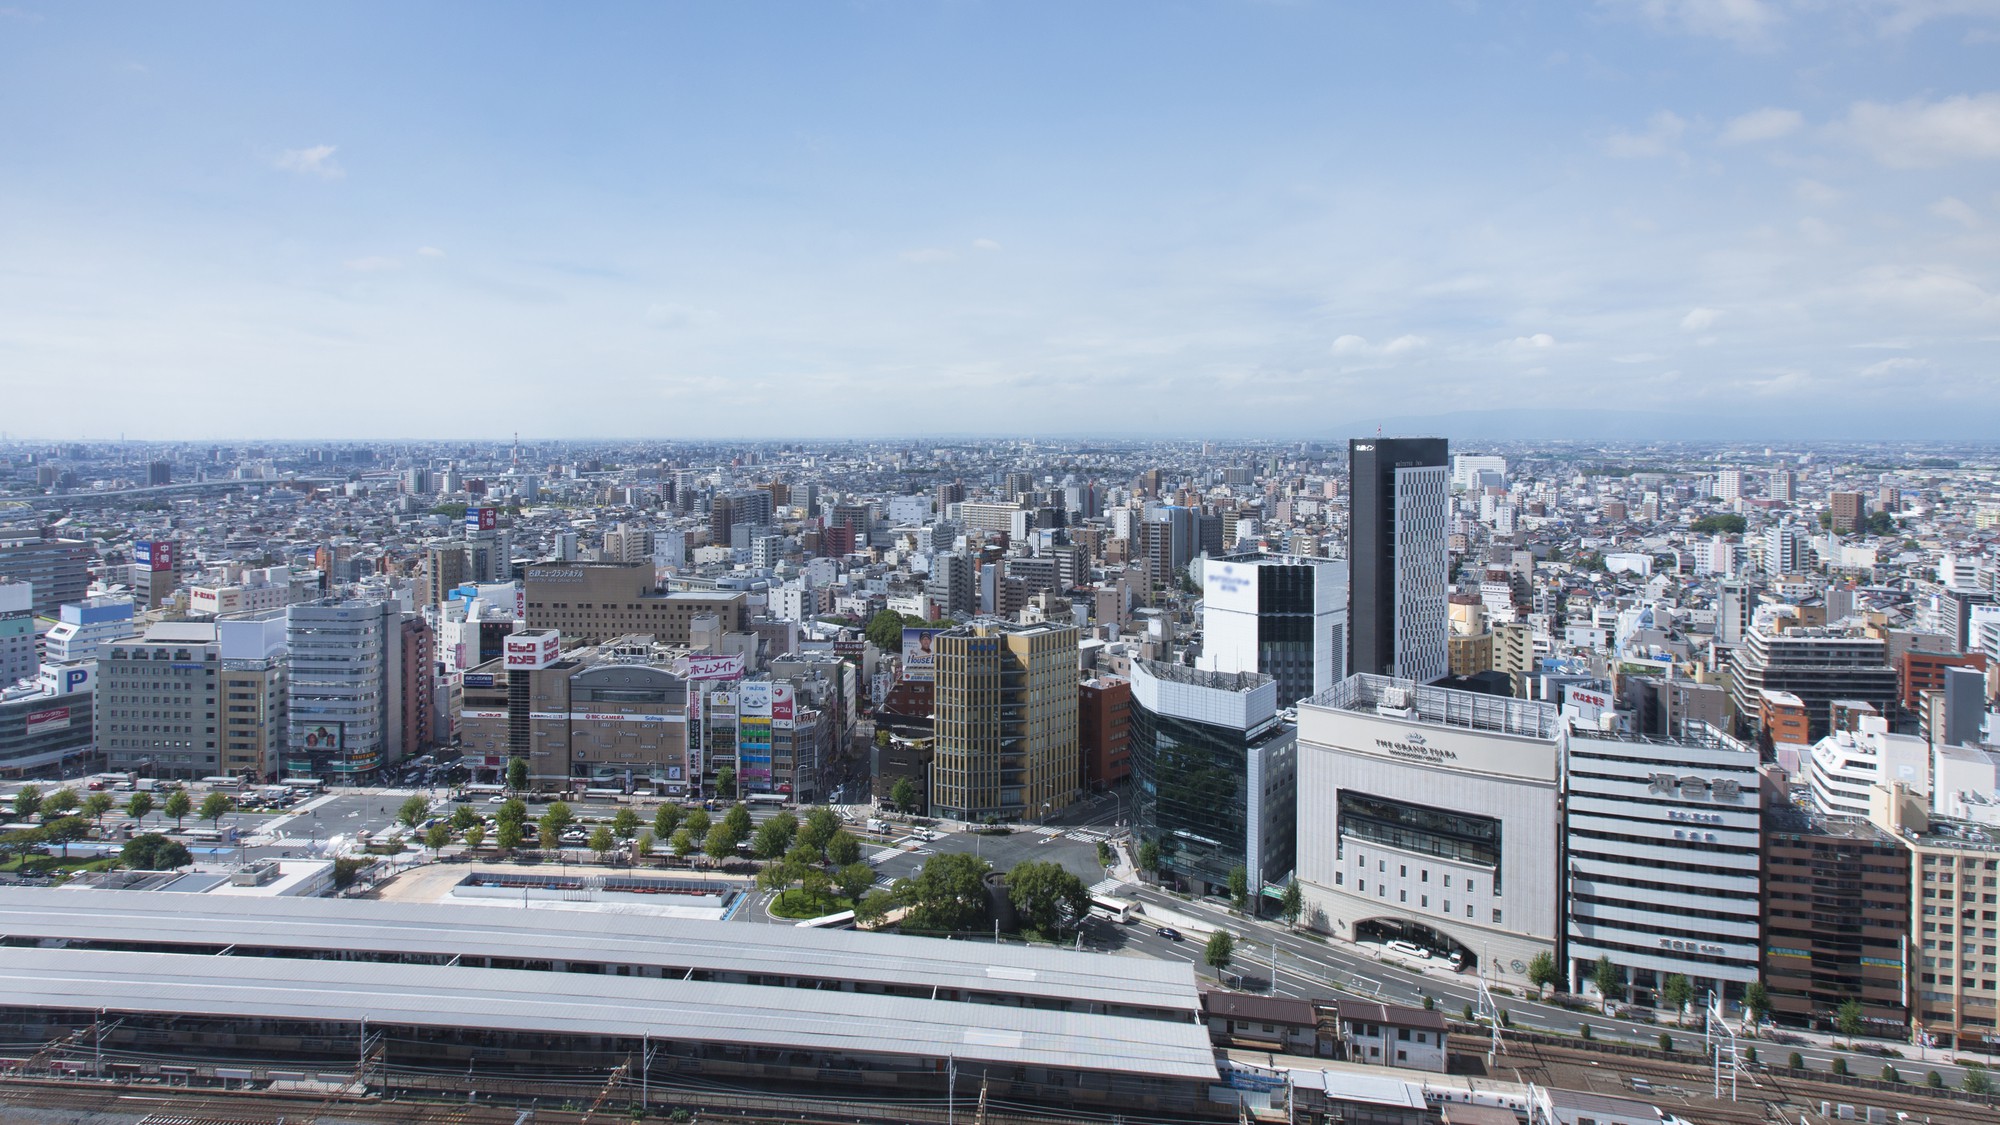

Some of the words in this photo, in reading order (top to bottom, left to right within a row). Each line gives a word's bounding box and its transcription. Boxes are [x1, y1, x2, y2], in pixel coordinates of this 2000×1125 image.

[508, 643, 536, 653] ビック
[508, 655, 536, 665] カメラ
[690, 661, 736, 675] ホームメイト
[67, 669, 88, 693] P
[1376, 739, 1393, 750] THE
[1394, 742, 1428, 755] GRAND
[1429, 747, 1458, 760] TIARA
[1648, 773, 1742, 802] 河合塾
